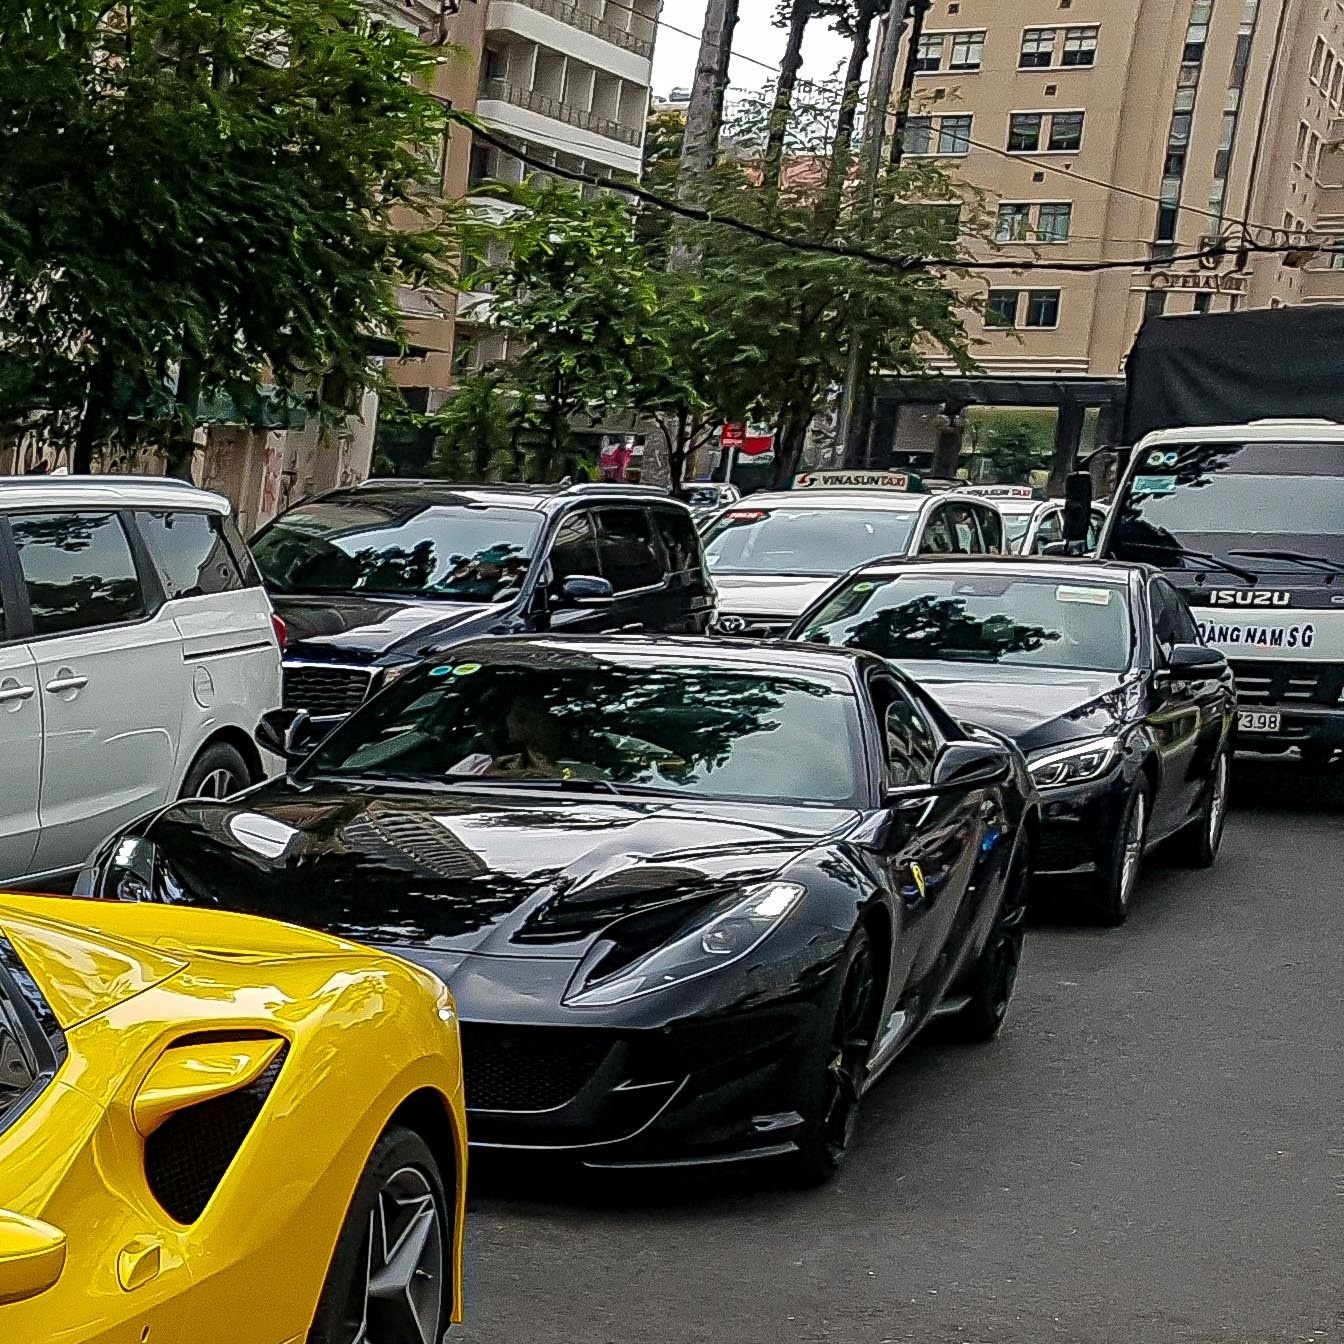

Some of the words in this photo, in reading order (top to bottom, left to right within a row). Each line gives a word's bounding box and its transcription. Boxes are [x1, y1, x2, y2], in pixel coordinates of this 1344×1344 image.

[823, 476, 881, 486] VINASUN
[881, 477, 905, 487] TAXI
[1210, 590, 1290, 605] ISUZU
[1245, 627, 1284, 647] NAM
[1287, 624, 1314, 648] SG
